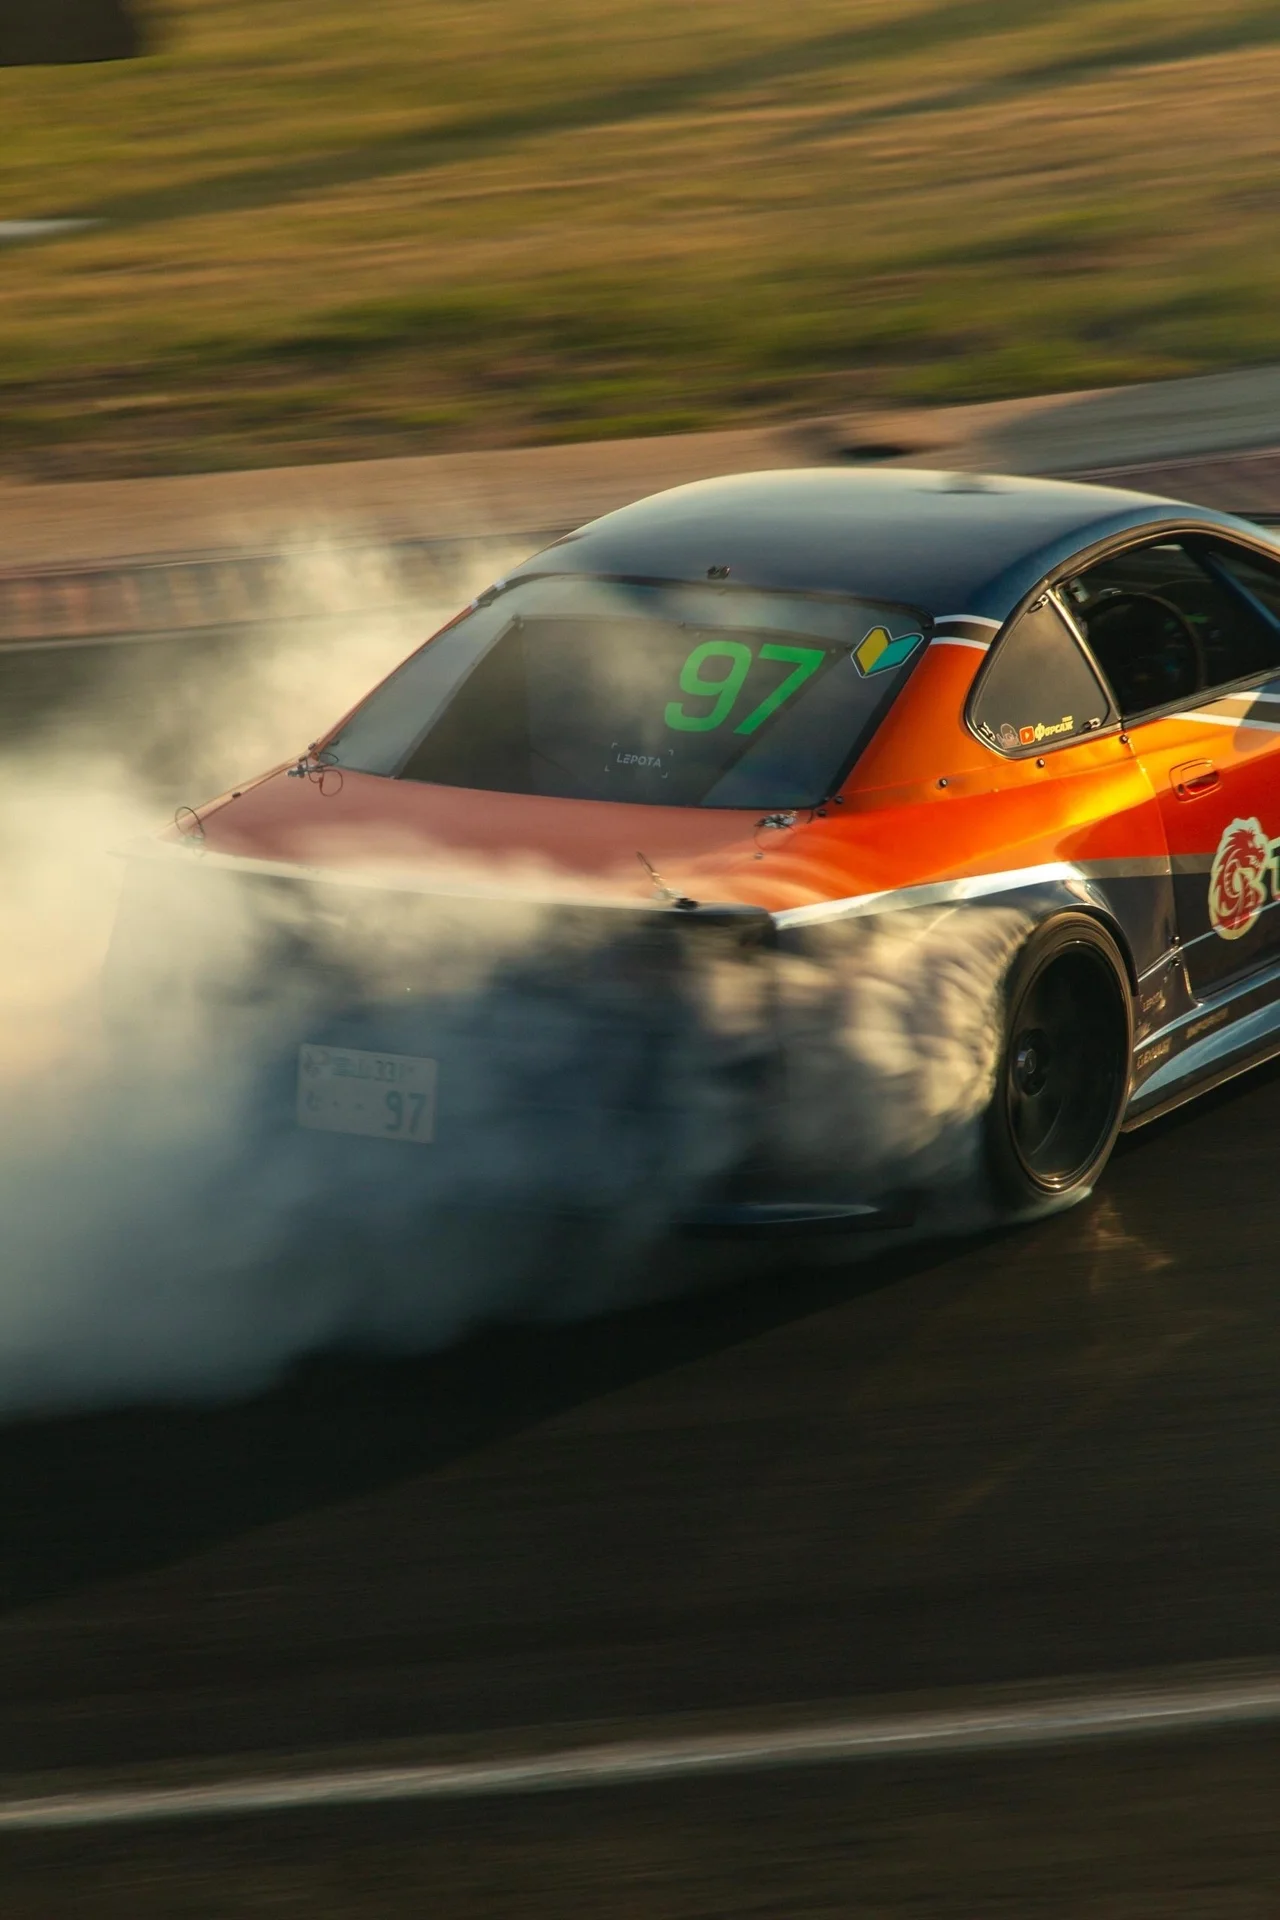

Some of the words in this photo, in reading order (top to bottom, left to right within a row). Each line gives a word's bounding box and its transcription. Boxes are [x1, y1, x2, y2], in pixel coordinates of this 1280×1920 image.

[664, 640, 826, 735] 97
[616, 752, 661, 768] LEPOTA
[384, 1090, 427, 1135] 97
